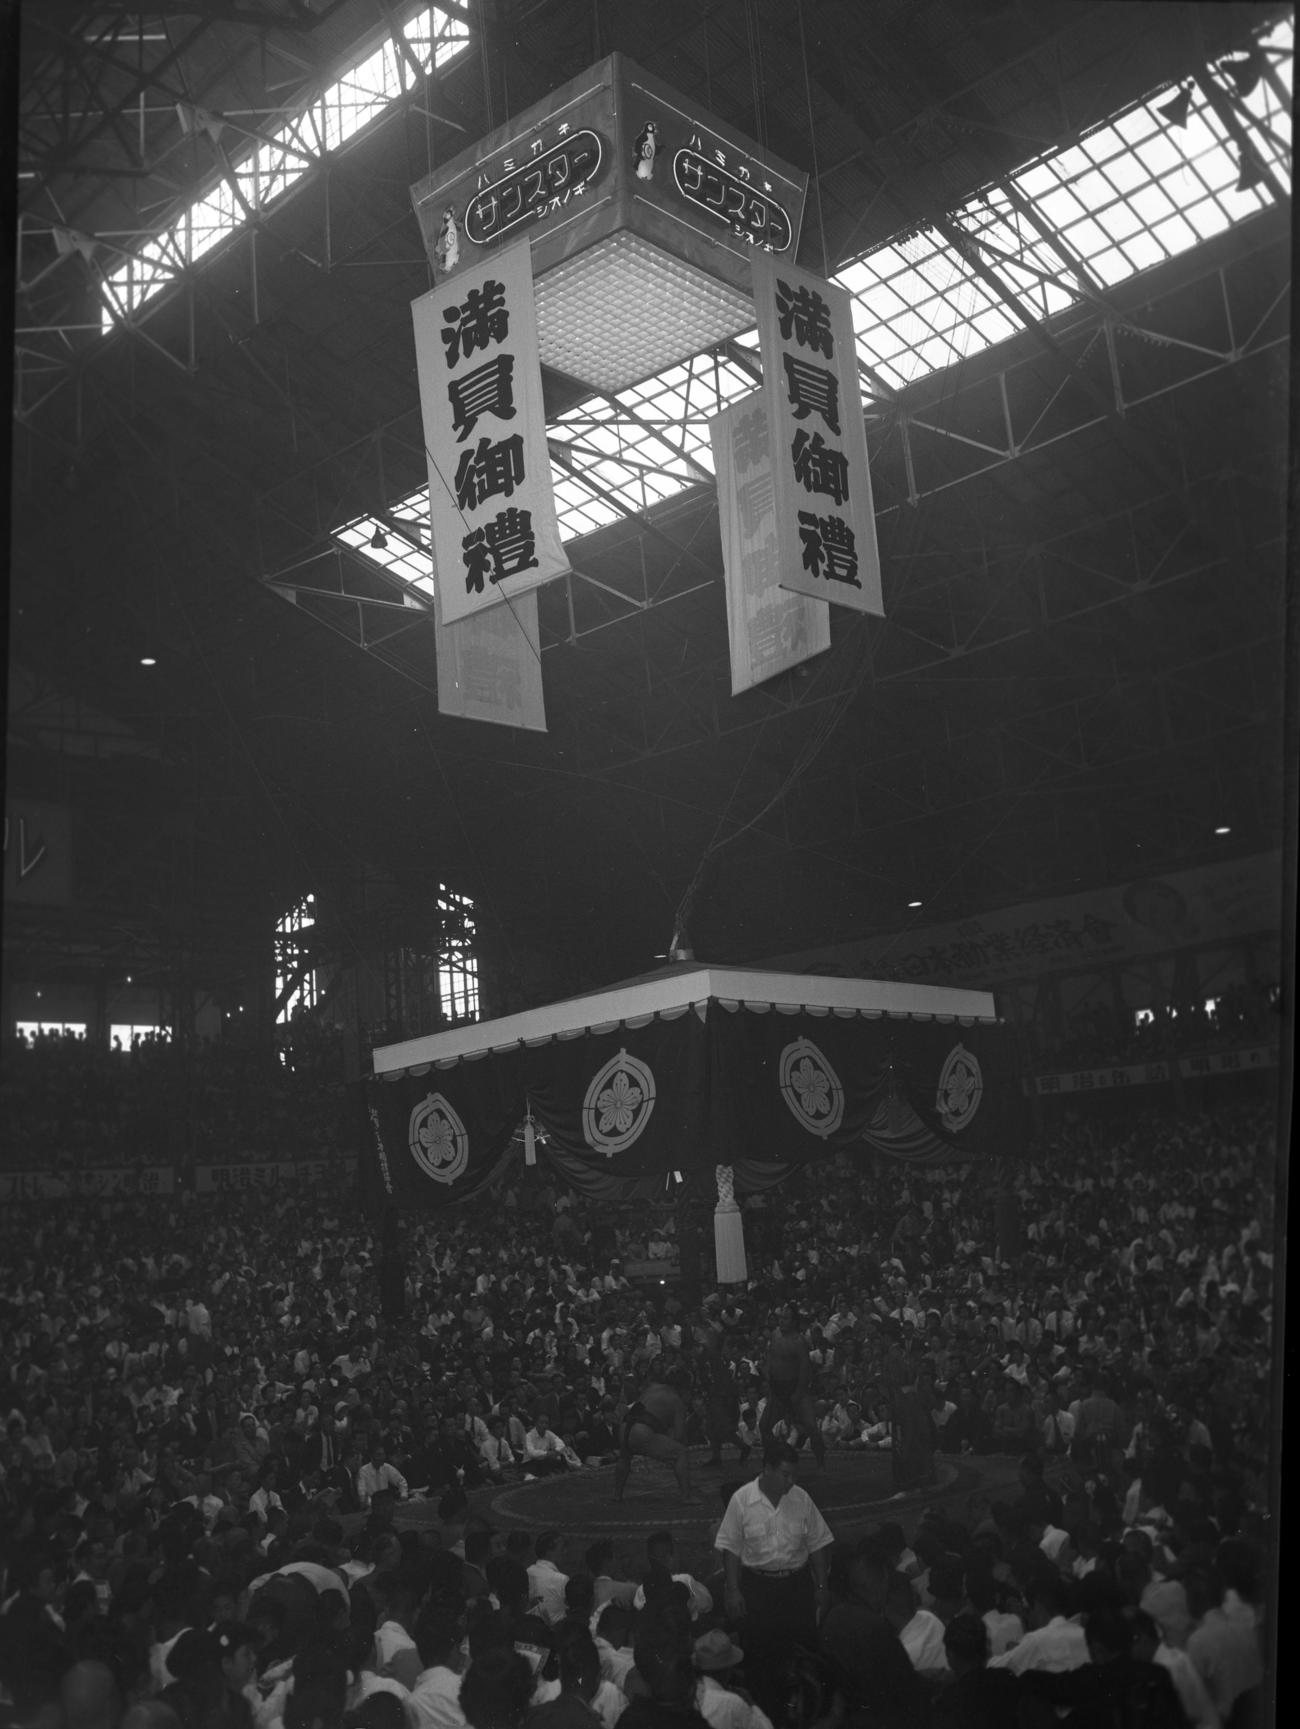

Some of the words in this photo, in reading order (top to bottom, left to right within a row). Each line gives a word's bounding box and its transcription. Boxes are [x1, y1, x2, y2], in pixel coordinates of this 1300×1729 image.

[475, 152, 589, 231] サンスター
[682, 158, 783, 231] サンスター
